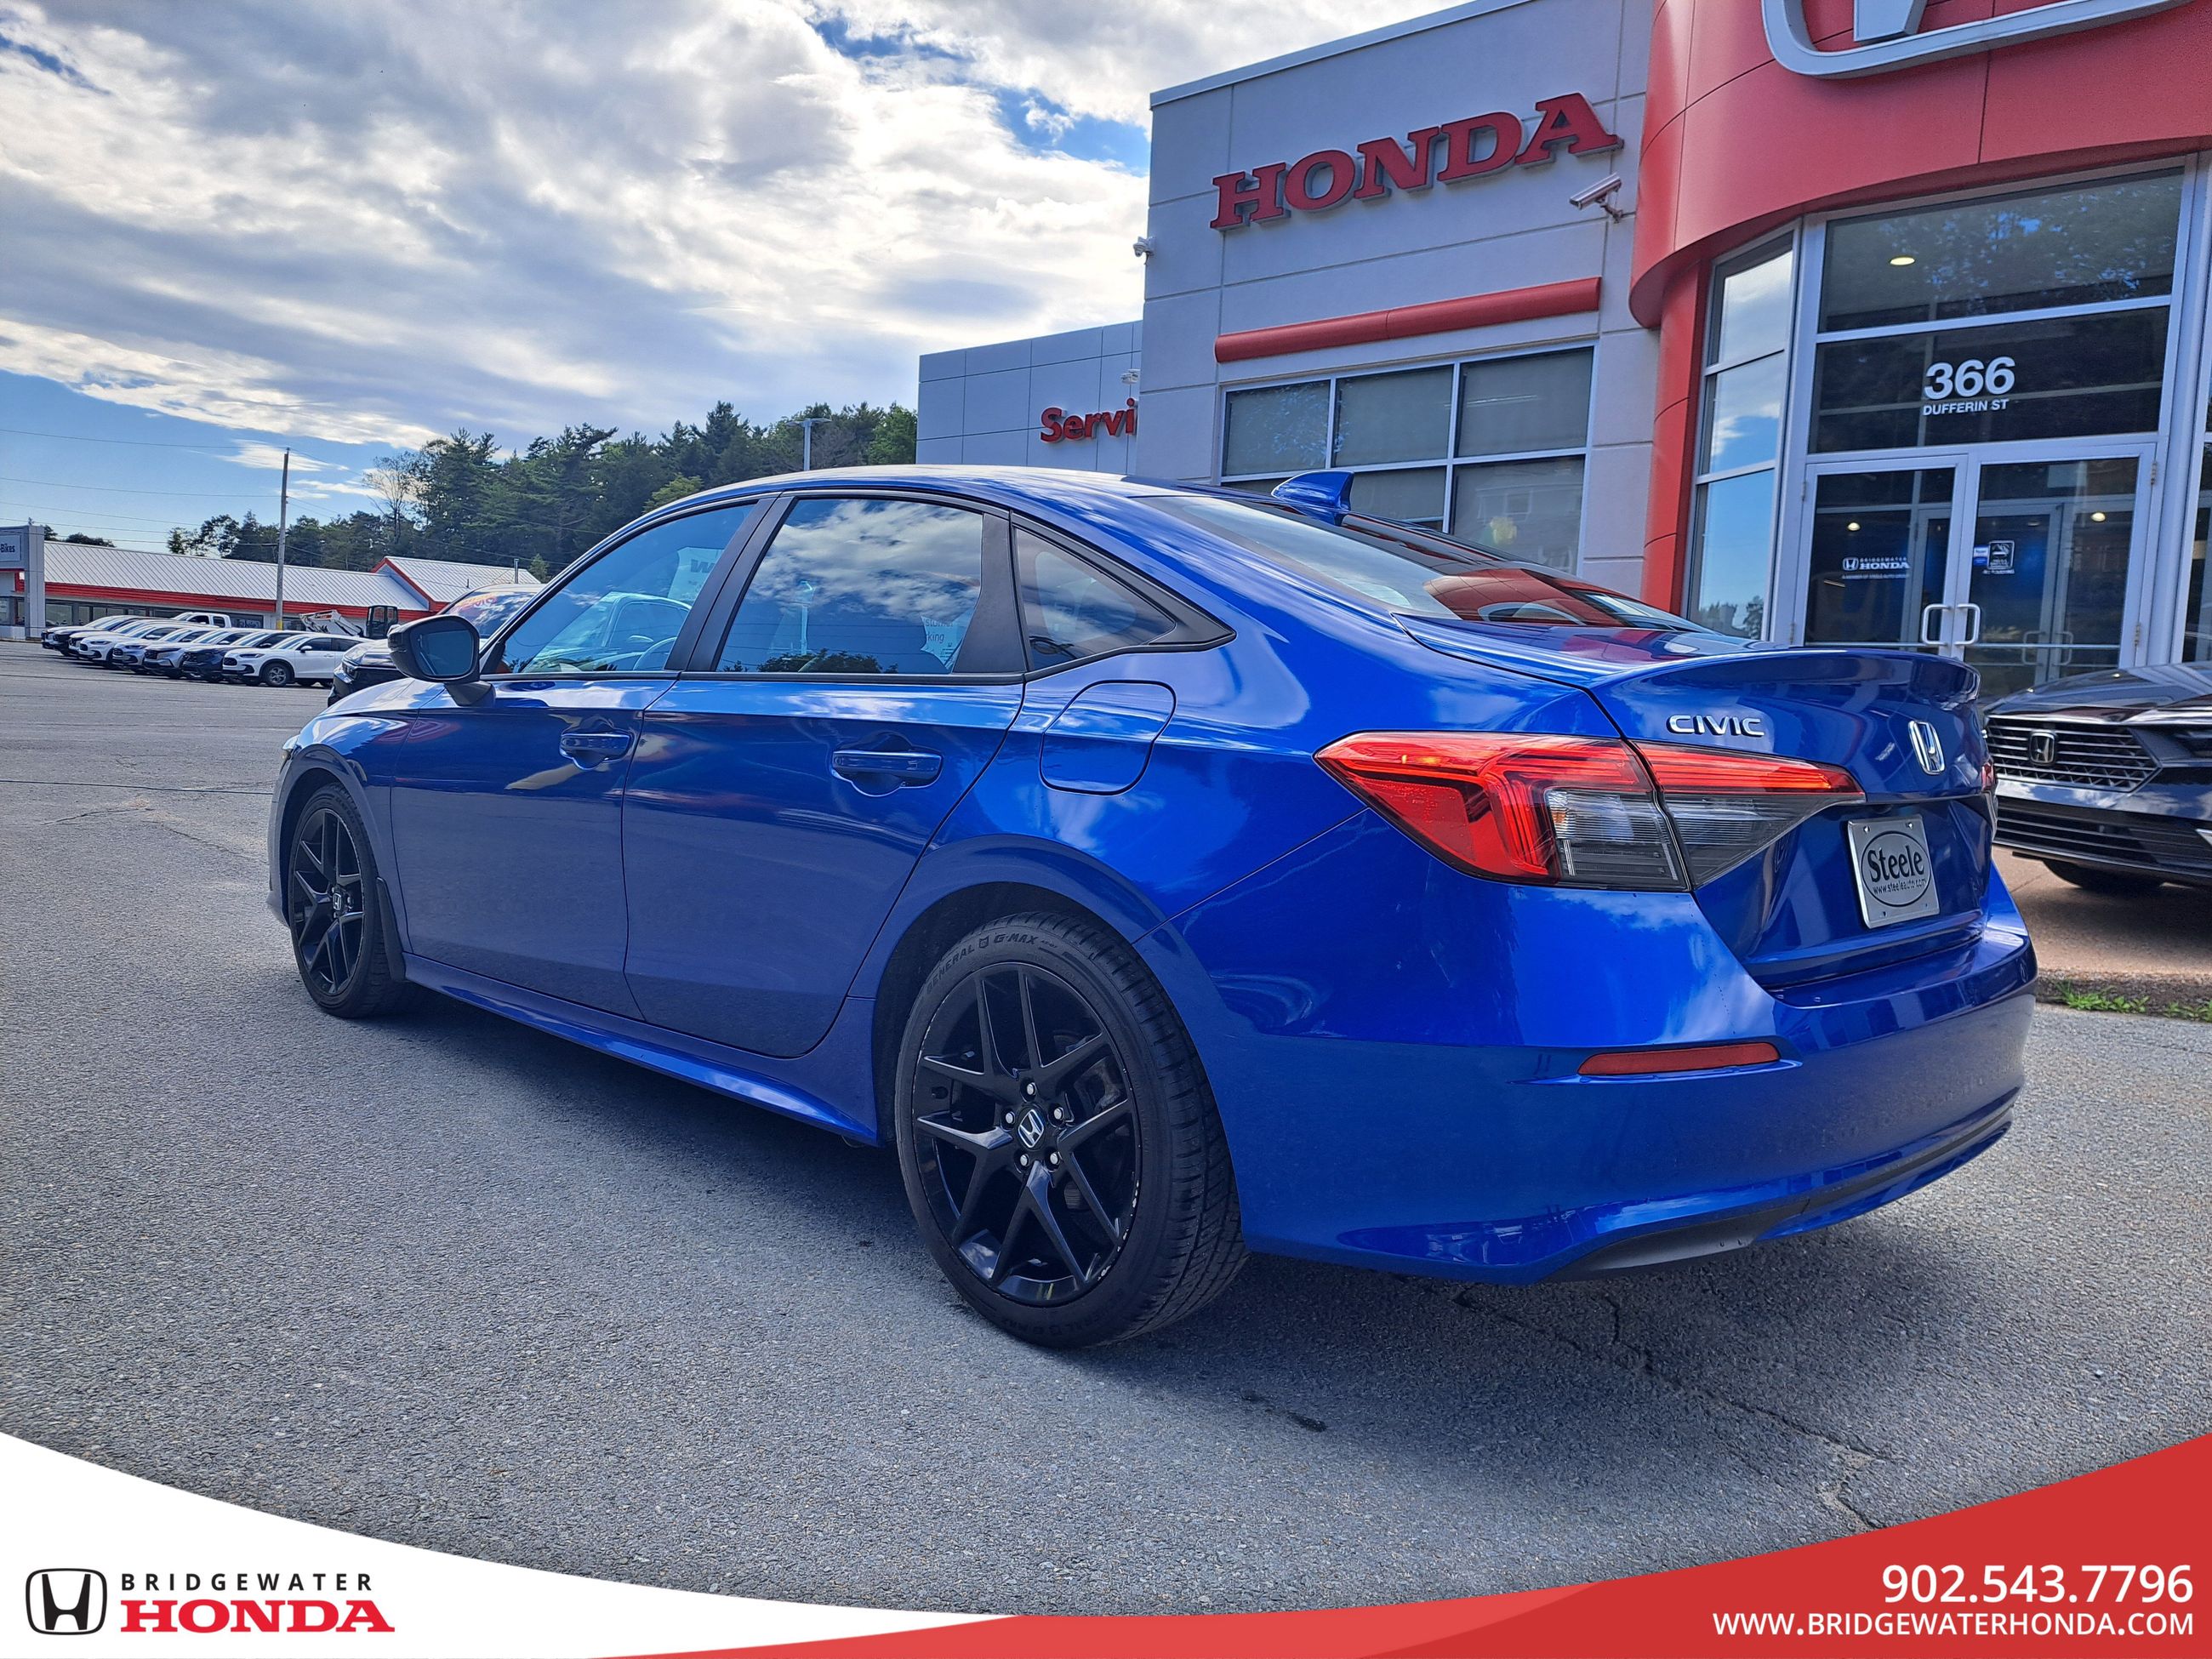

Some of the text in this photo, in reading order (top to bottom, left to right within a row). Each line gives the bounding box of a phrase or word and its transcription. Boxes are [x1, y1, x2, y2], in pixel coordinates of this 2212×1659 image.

[1210, 92, 1623, 231] HONDA
[1924, 356, 2015, 400] 366
[1040, 397, 1136, 442] Servi
[1923, 399, 2010, 416] DUFFERIN ST
[1667, 715, 1765, 737] CIVIC
[1867, 845, 1925, 882] Steele
[926, 944, 975, 995] GENERAL
